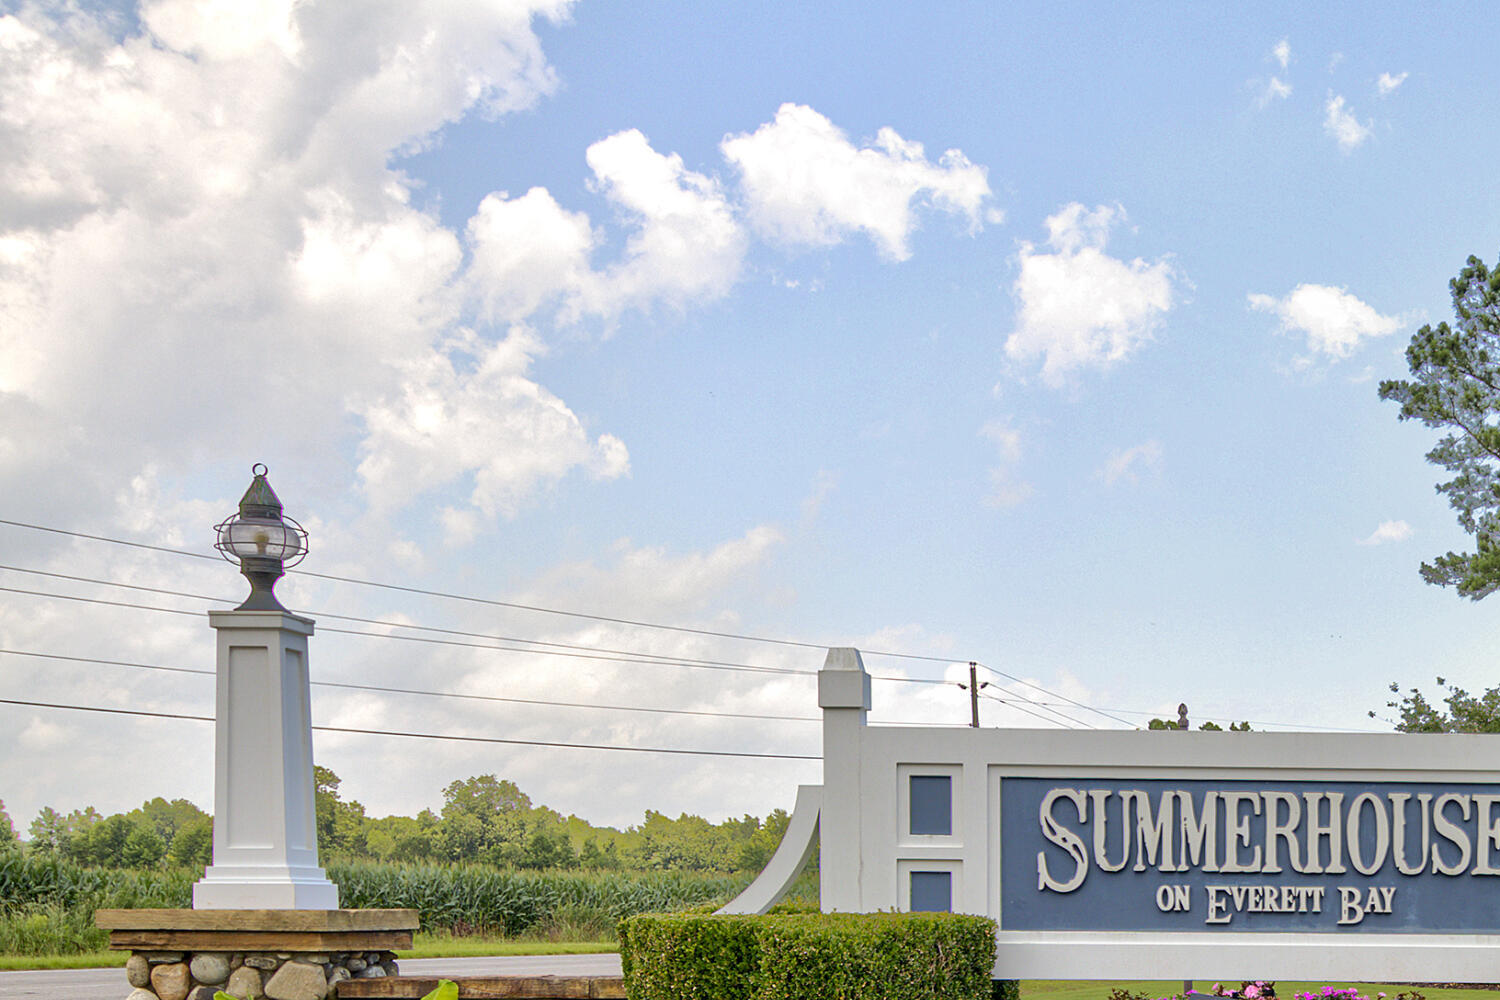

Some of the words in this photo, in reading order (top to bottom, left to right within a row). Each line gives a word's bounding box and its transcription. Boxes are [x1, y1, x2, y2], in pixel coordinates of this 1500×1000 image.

[1156, 884, 1190, 912] ON
[1205, 885, 1325, 924] EVERETT
[1337, 886, 1397, 925] BAY
